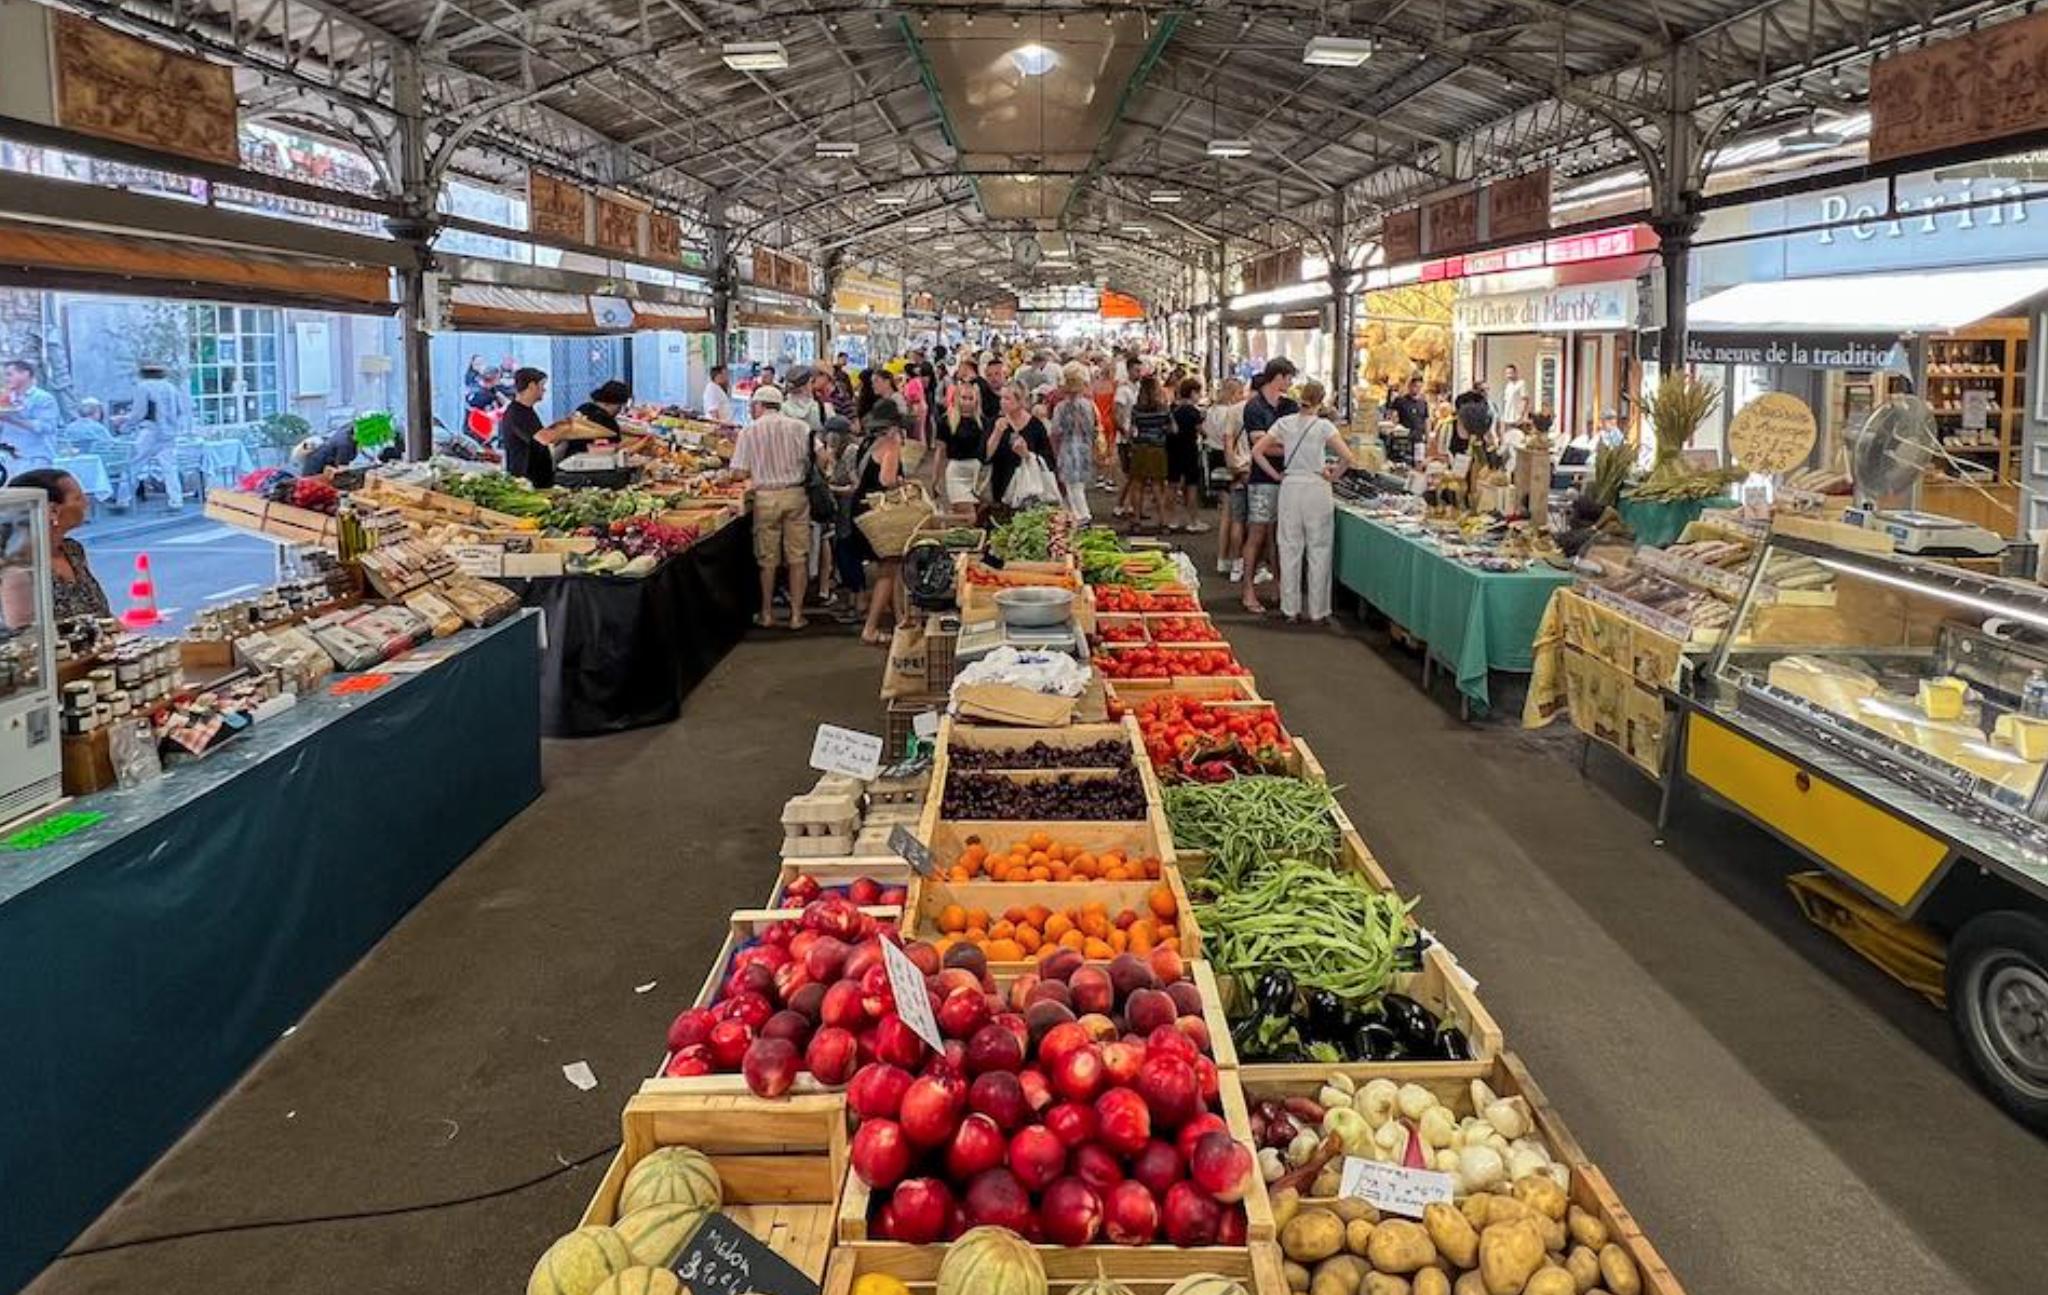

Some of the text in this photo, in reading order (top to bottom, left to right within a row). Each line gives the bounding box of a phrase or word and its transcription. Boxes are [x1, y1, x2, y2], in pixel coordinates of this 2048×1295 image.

[1819, 178, 2027, 244] Perrin
[1521, 297, 1539, 323] du
[1543, 290, 1600, 322] Marché
[1686, 341, 1894, 366] dée neuve de la traditio
